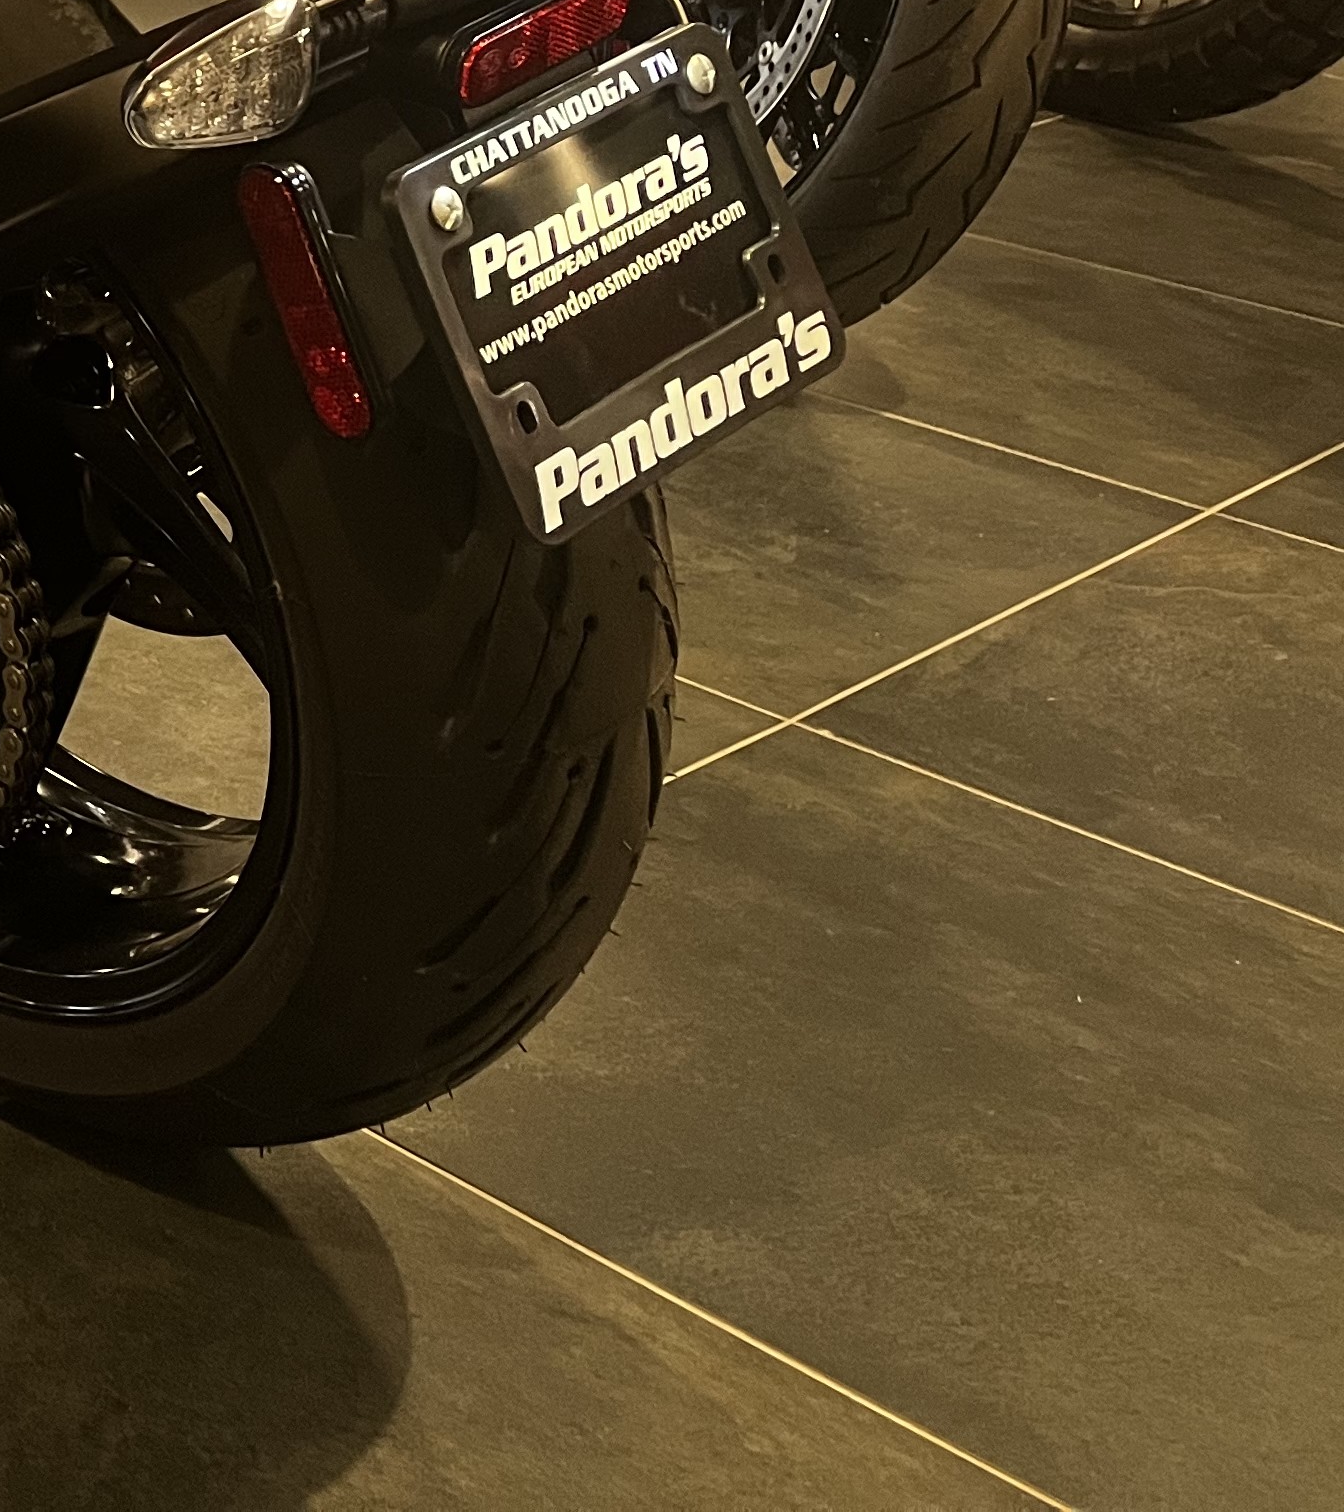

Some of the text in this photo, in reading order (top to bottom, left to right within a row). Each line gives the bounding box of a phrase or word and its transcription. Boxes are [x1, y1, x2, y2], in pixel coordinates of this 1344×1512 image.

[450, 48, 679, 185] CHATTANOOGA TN
[469, 133, 709, 299] Pandora's
[479, 200, 747, 364] www.pandorasmotorsports.com
[511, 177, 712, 306] EUROPEAN MOTORSPORTS
[534, 310, 831, 534] Pandora's
